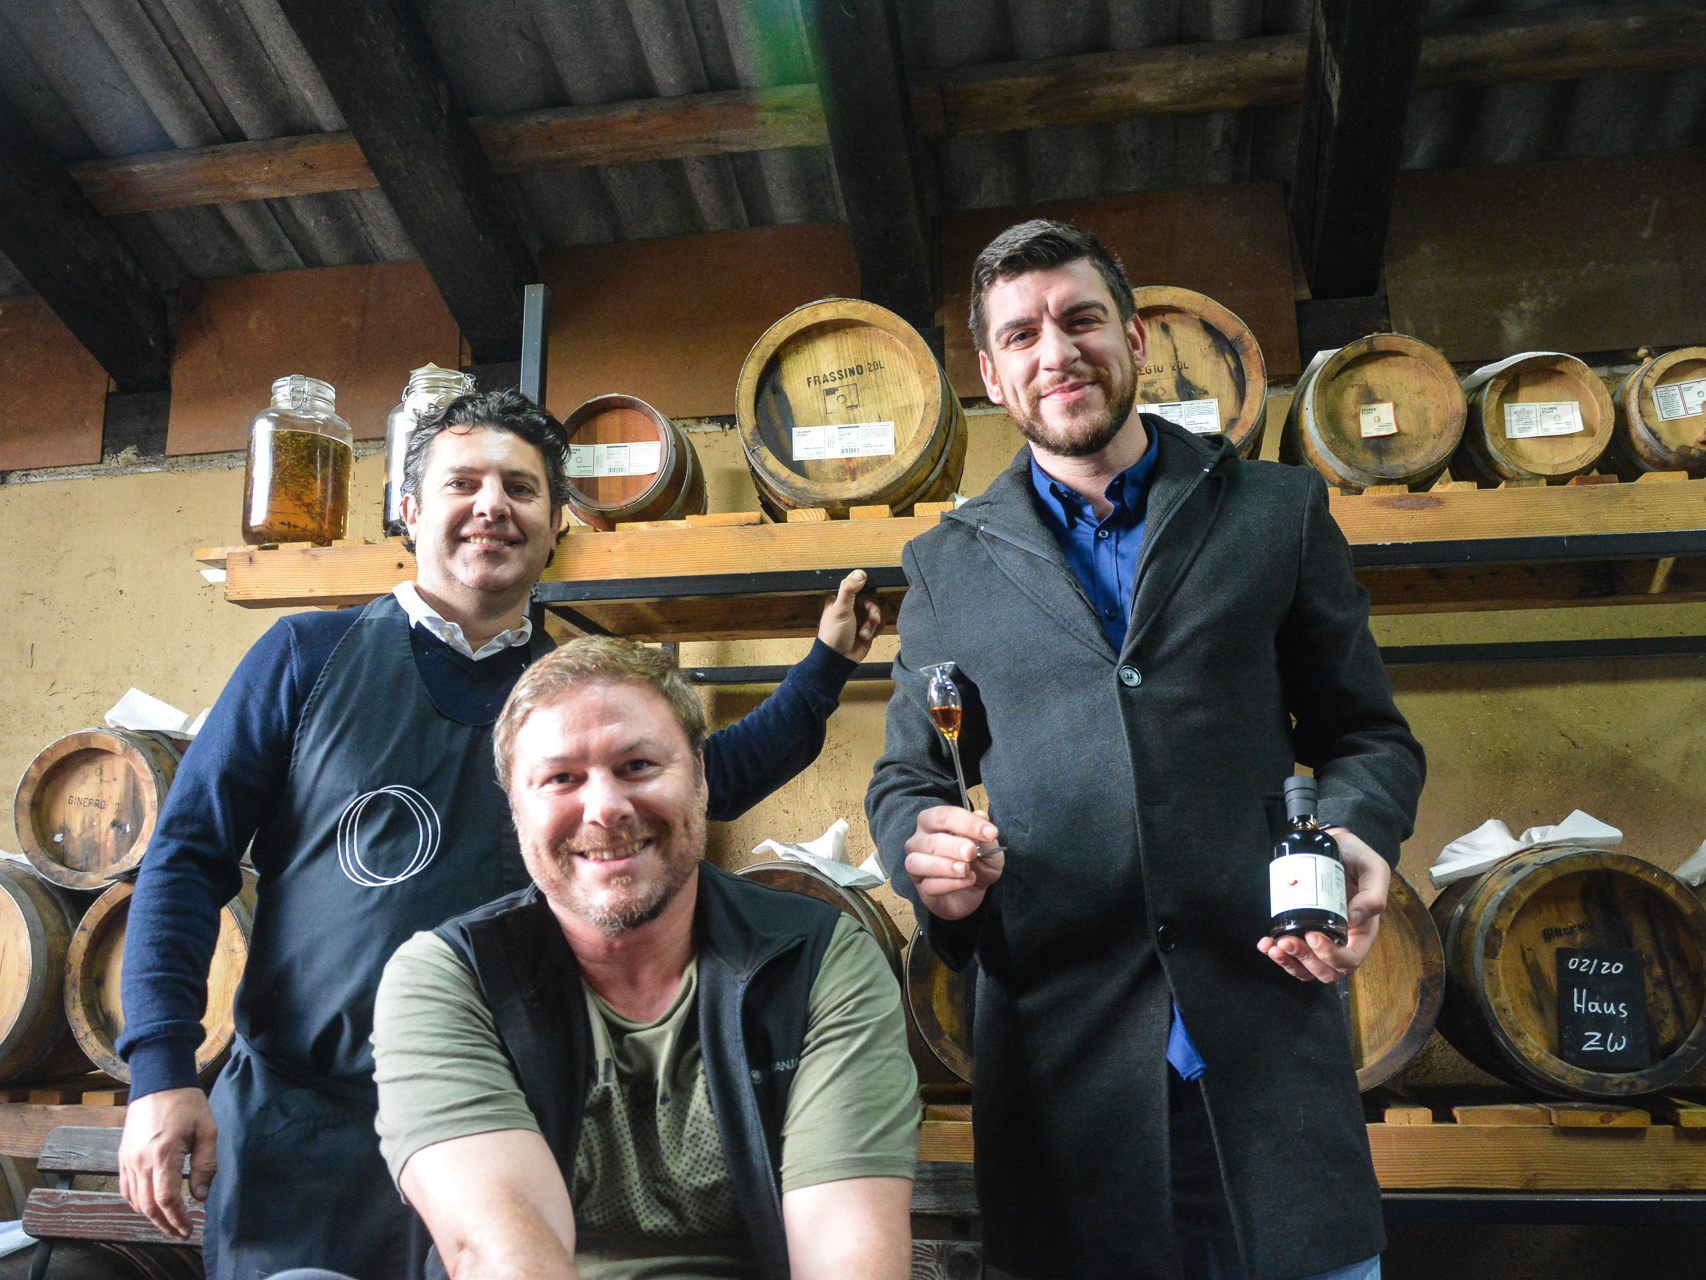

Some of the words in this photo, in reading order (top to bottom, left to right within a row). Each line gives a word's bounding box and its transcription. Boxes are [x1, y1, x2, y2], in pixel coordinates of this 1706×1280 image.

[806, 364, 864, 388] FRASSINO
[867, 360, 885, 373] 20L
[67, 795, 107, 810] GINEPRO
[1568, 957, 1624, 975] 02/20
[1573, 987, 1628, 1018] Haus
[1581, 1031, 1627, 1053] ZW
